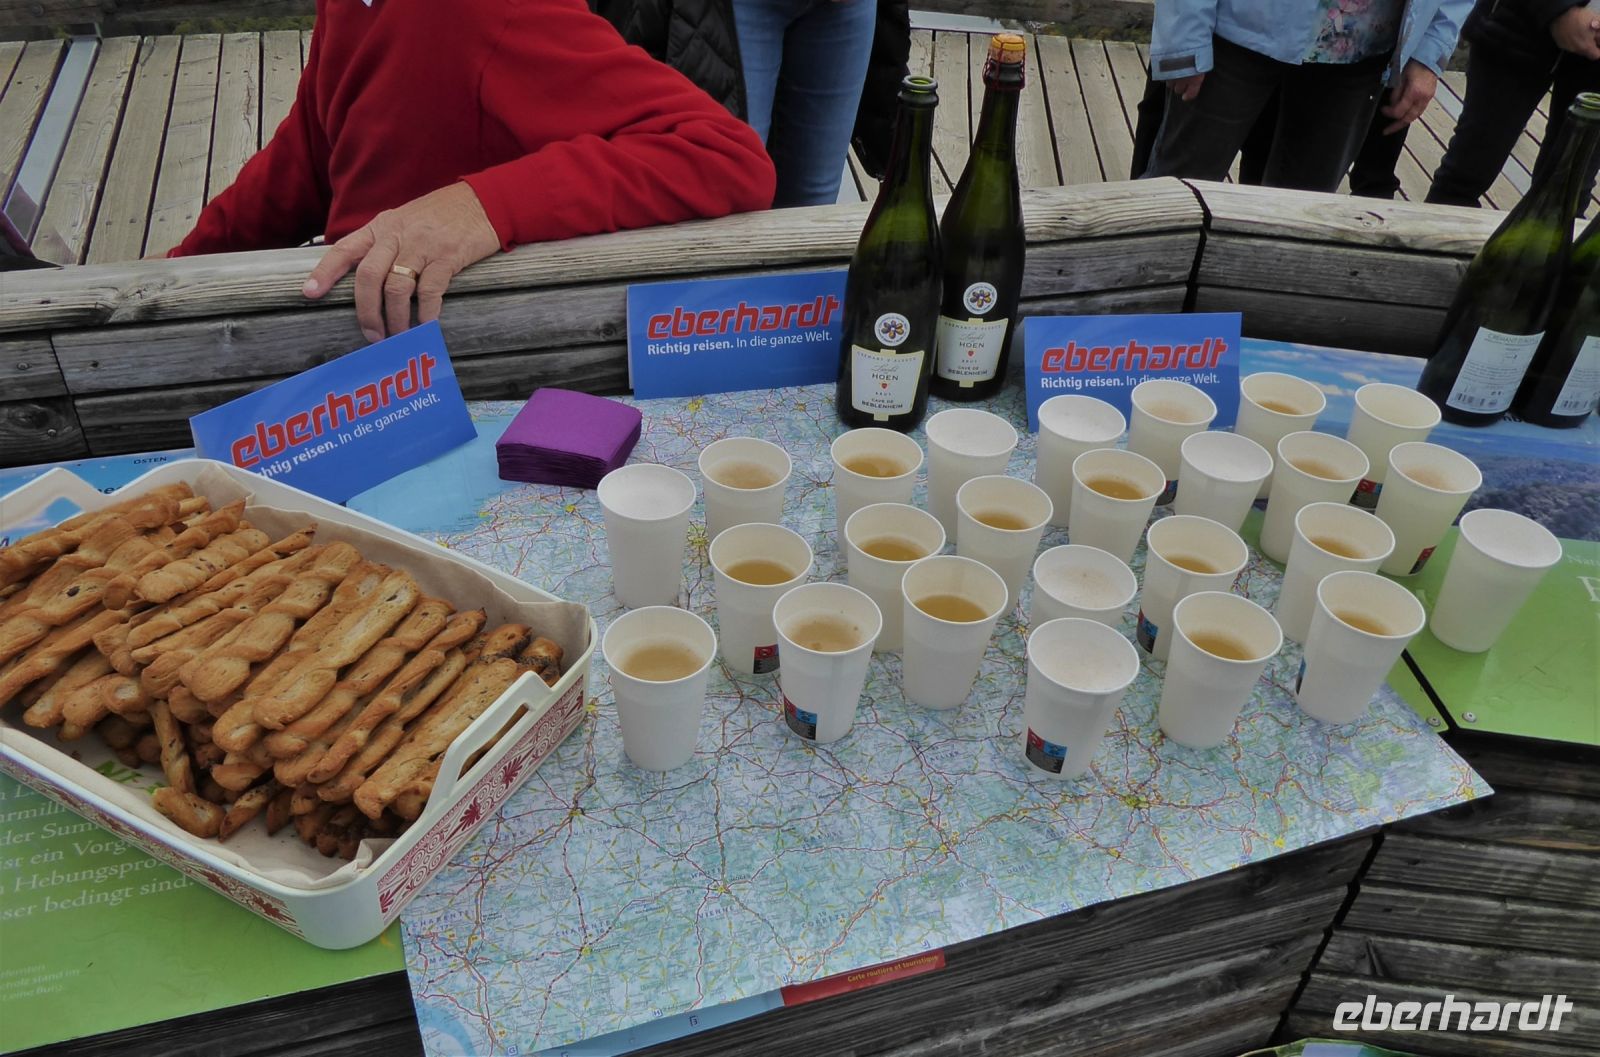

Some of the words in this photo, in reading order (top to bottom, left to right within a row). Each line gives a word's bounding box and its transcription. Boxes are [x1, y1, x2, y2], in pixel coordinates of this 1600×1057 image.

[647, 295, 840, 339] eberhardt
[647, 341, 690, 356] Richtig
[694, 339, 734, 351] reisen.
[737, 338, 747, 348] In
[750, 335, 767, 347] die
[770, 334, 803, 347] ganze
[804, 330, 833, 342] Welt.
[959, 341, 985, 349] HOEN
[1040, 337, 1229, 373] eberhardt
[872, 372, 899, 381] HOEN
[1041, 377, 1082, 391] Richtig
[1084, 376, 1124, 388] reisen.
[1126, 375, 1136, 386] In
[1193, 372, 1221, 385] Welt.
[231, 353, 436, 468] eberhardt
[260, 459, 292, 479] htig
[293, 440, 338, 465] reisen.
[338, 433, 352, 446] In
[354, 422, 373, 439] die
[375, 407, 411, 432] ganze
[410, 393, 441, 413] Welt.
[133, 456, 167, 465] OSTEN
[41, 822, 99, 839] Sum
[30, 848, 64, 865] ein
[44, 888, 135, 913] bedingt
[140, 875, 195, 896] sind.
[848, 972, 865, 982] Carte
[894, 962, 902, 971] et
